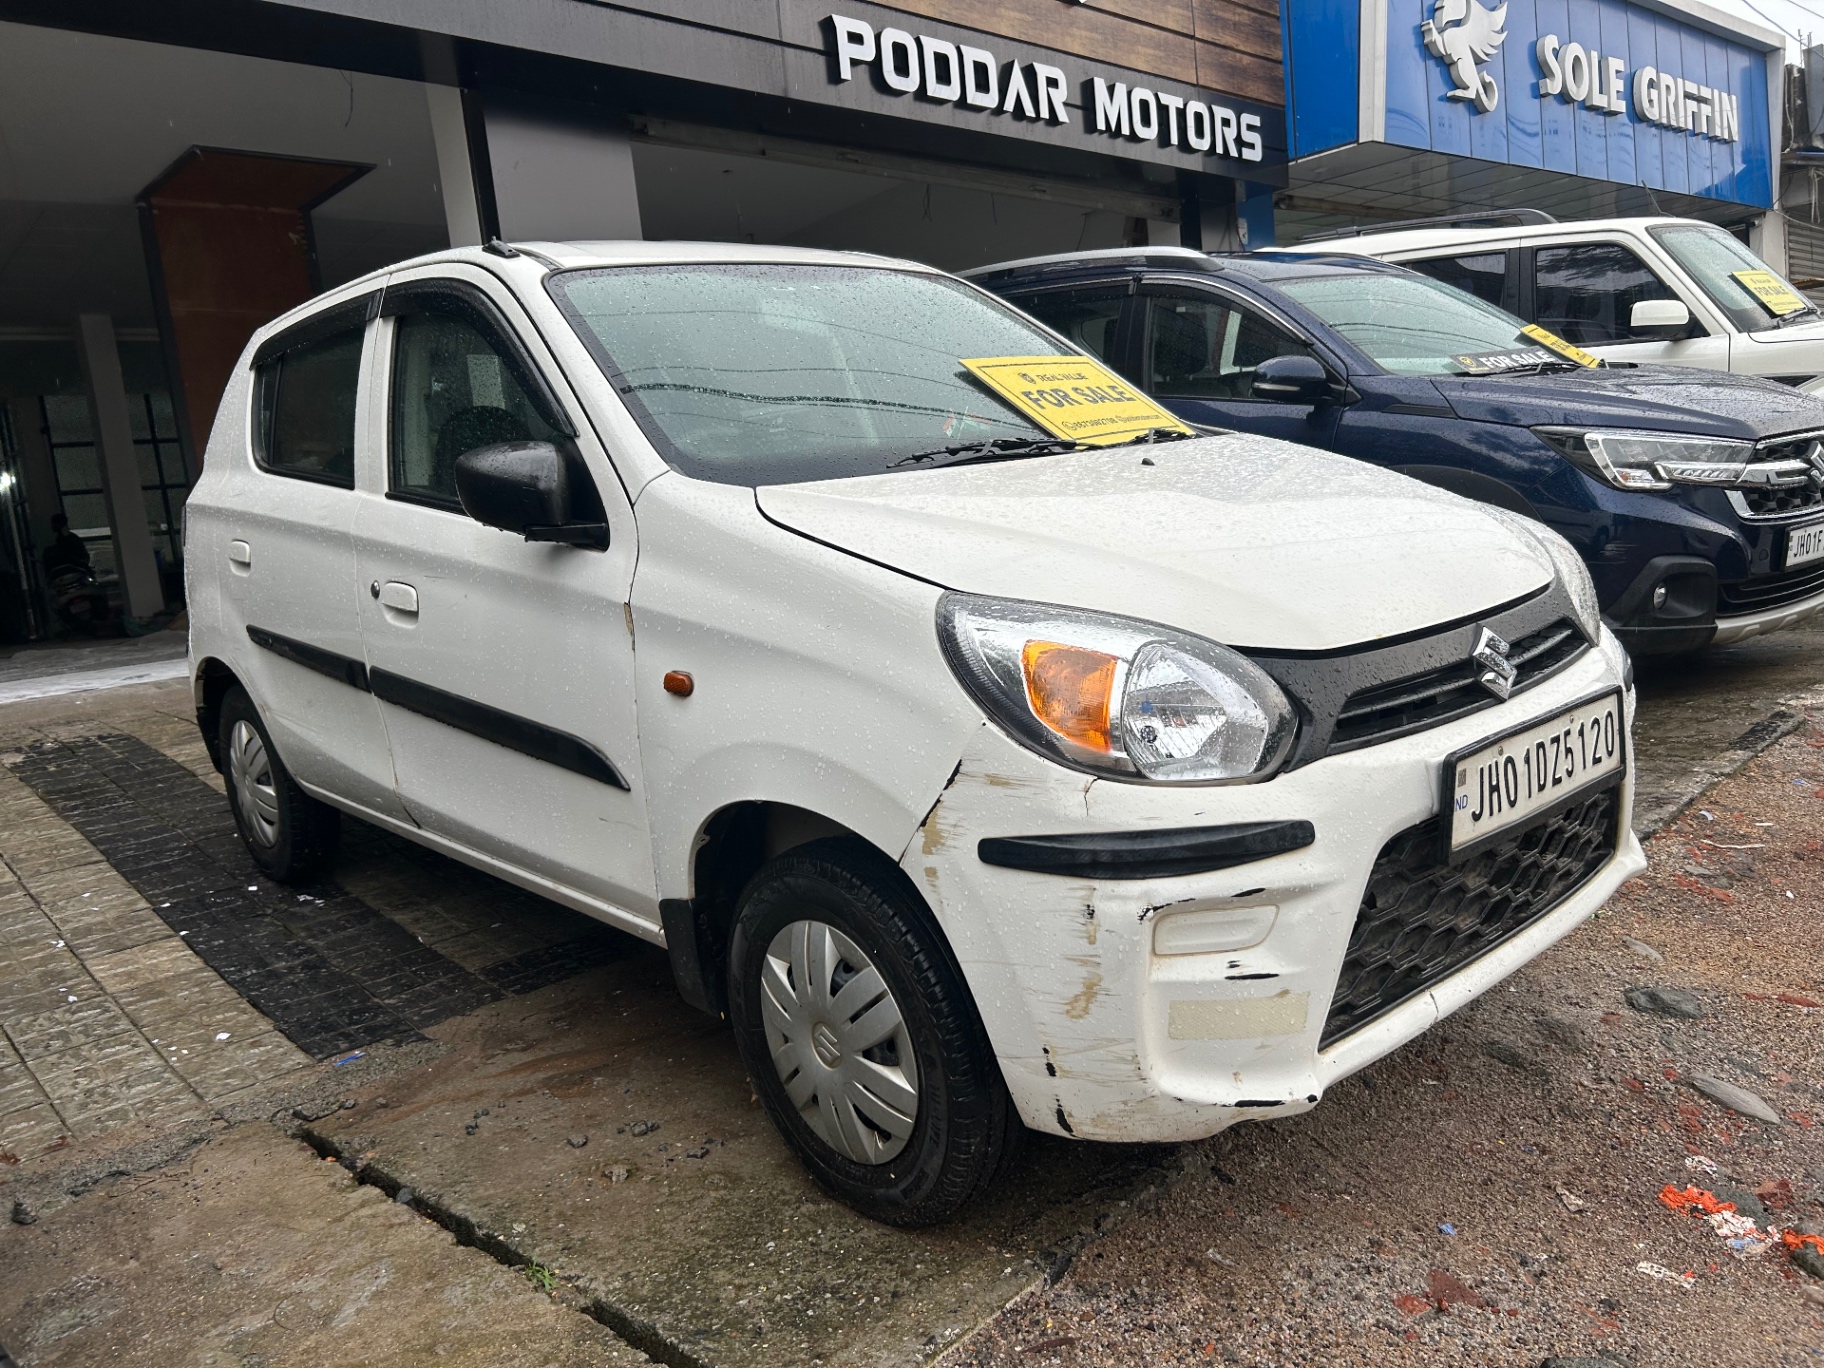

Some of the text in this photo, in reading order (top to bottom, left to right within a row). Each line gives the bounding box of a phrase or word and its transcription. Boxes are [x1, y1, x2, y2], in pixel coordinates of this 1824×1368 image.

[831, 14, 1263, 163] PODDAR MOTORS
[1536, 33, 1739, 143] SOLE GRIFFIN
[1478, 355, 1518, 369] FOR
[1511, 350, 1555, 365] SALE
[1021, 384, 1137, 410] FOR SALE
[1793, 529, 1824, 558] JH01F
[1471, 710, 1615, 823] JH01DZ5120
[1455, 794, 1469, 812] ND
